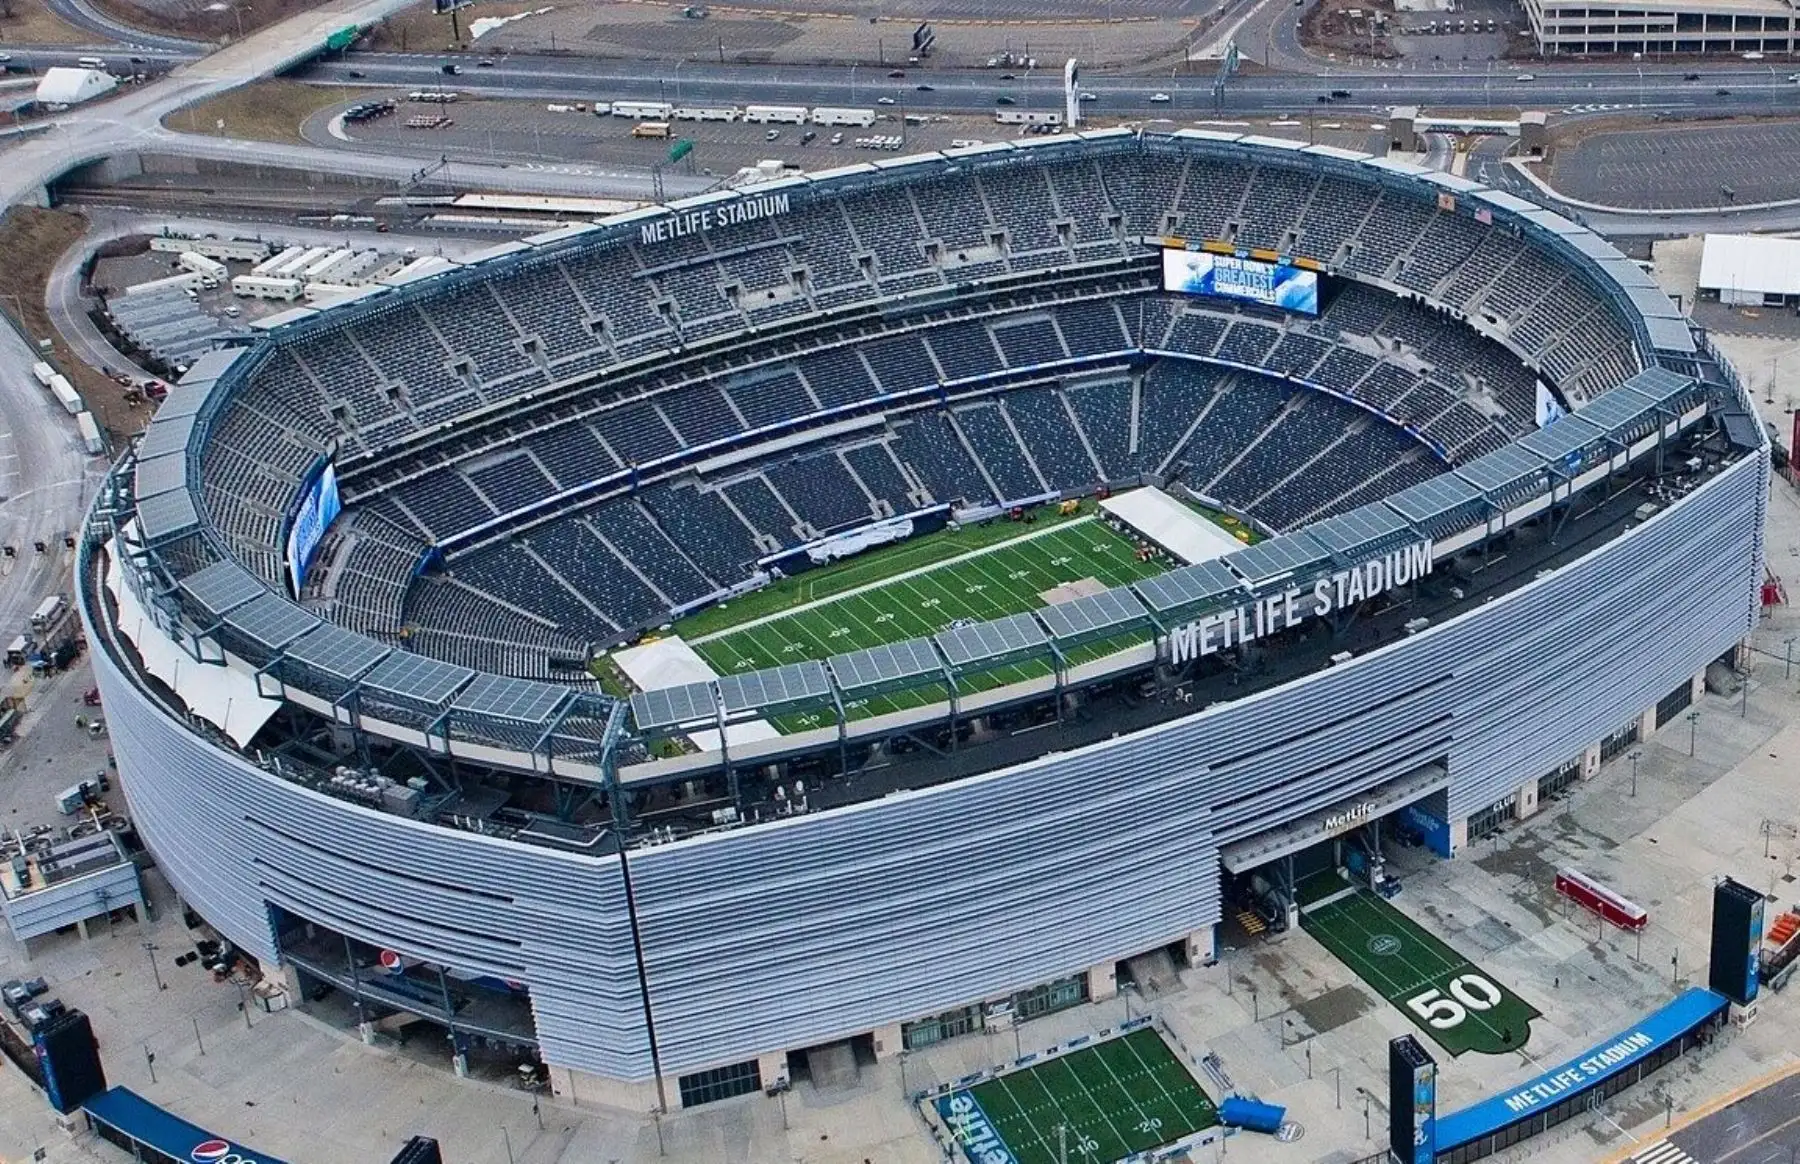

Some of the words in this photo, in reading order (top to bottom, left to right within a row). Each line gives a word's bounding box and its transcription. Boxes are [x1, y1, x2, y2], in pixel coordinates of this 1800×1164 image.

[641, 209, 712, 244] METLIFE
[718, 194, 790, 227] STADIUM
[1215, 267, 1274, 291] GREATEST
[1171, 588, 1302, 665] METLIFE
[1314, 539, 1432, 616] STADIUM
[1325, 802, 1376, 831] MetLife
[1406, 974, 1502, 1029] 50
[1504, 1066, 1585, 1112] METLIFE
[1579, 1032, 1653, 1076] STADIUM
[948, 1097, 1016, 1164] etLife
[1139, 1117, 1163, 1133] 20
